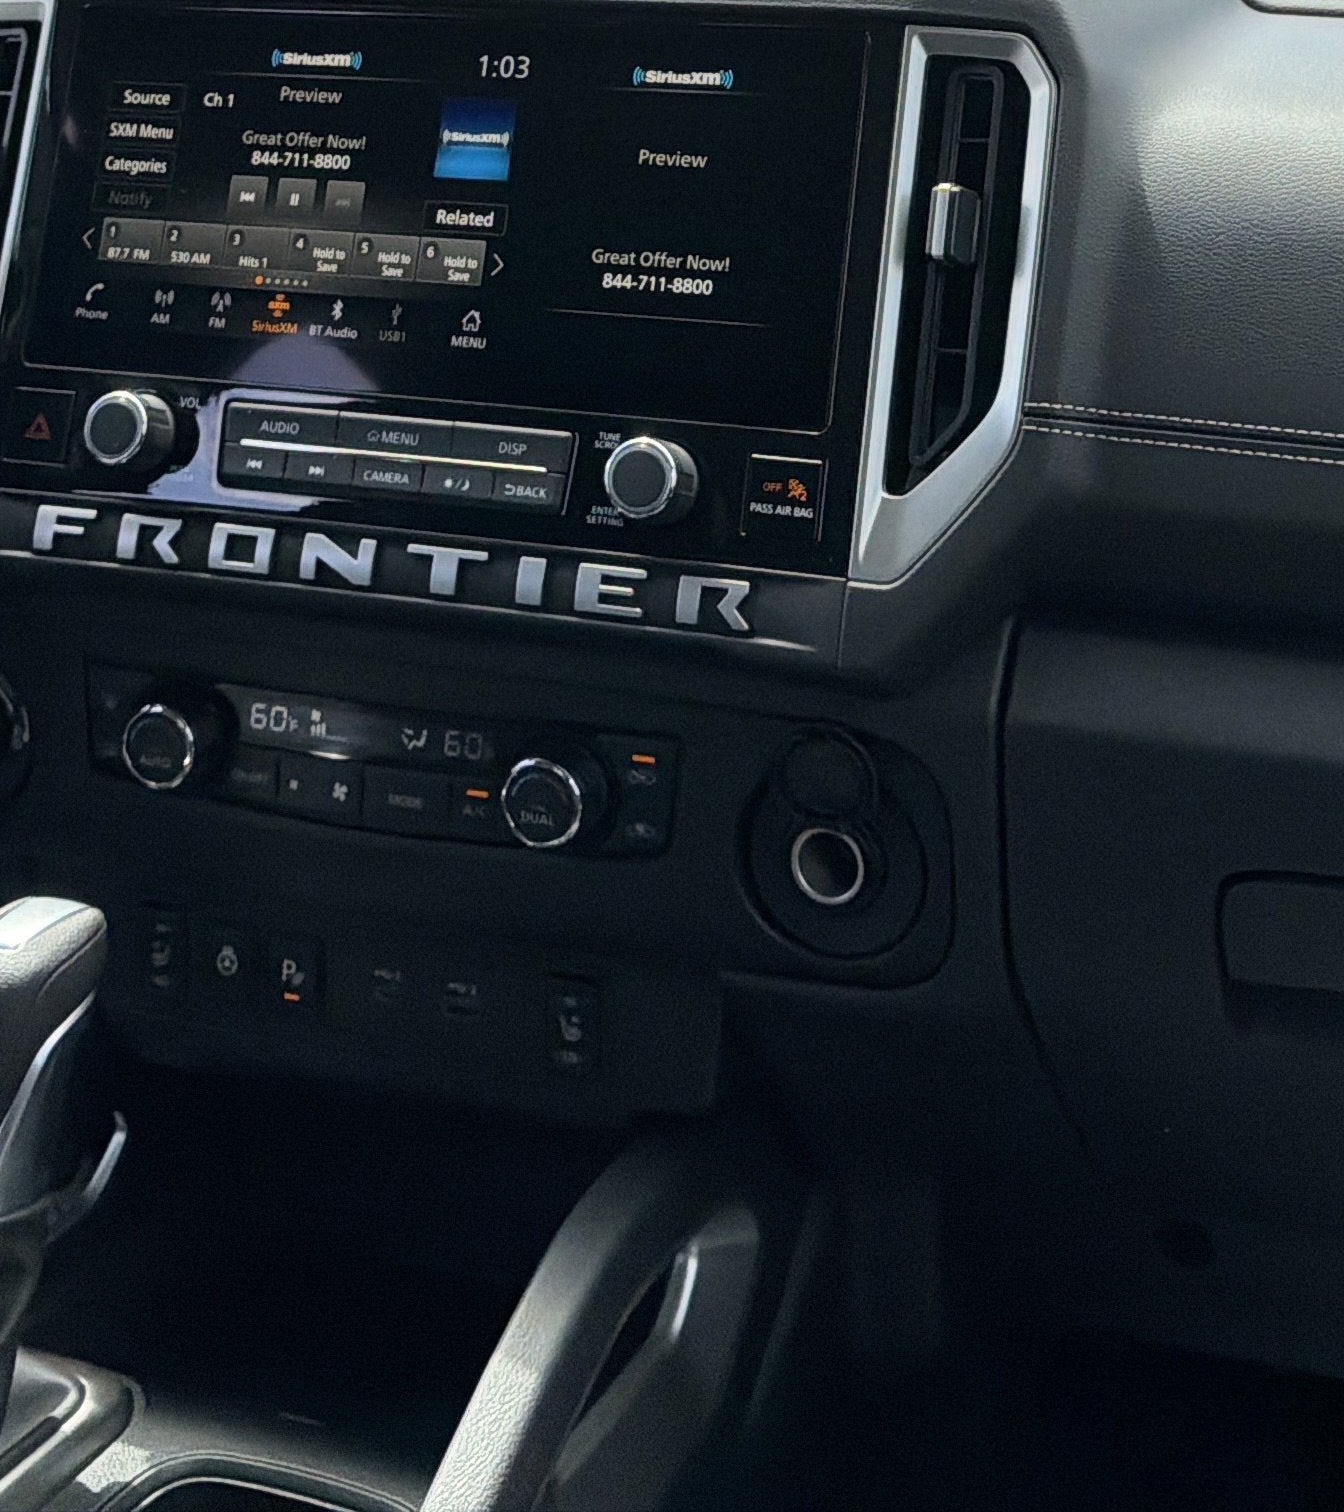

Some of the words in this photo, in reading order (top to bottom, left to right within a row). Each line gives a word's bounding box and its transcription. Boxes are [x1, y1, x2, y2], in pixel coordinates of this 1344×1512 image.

[479, 54, 531, 79] 1:03
[122, 88, 171, 106] Source
[203, 92, 223, 108] Ch
[226, 93, 236, 108] 1
[279, 85, 343, 104] Preview
[109, 121, 138, 138] SXM
[139, 123, 175, 140] Menu
[242, 129, 283, 147] Great
[285, 131, 325, 149] Offer
[327, 134, 367, 151] Now!
[104, 155, 168, 176] Categories
[250, 150, 351, 170] 844-711-8800
[637, 148, 709, 169] Preview
[108, 190, 153, 210] Notify
[435, 208, 495, 228] Related
[109, 225, 117, 238] 1
[169, 229, 179, 242] 2
[231, 233, 241, 246] 3
[295, 237, 305, 250] 4
[360, 241, 370, 254] 5
[132, 248, 150, 261] FM
[190, 252, 211, 265] AM
[312, 246, 334, 260] Hold
[334, 249, 346, 261] to
[377, 251, 400, 264] Hold
[400, 253, 412, 265] to
[426, 246, 435, 258] 6
[238, 255, 260, 268] Hits
[261, 257, 268, 269] 1
[316, 260, 338, 274] Save
[443, 255, 466, 269] Hold
[467, 257, 478, 270] to
[591, 248, 636, 266] Great
[639, 251, 683, 269] Offer
[686, 254, 731, 273] Now!
[381, 265, 404, 278] Save
[447, 269, 471, 283] Save
[602, 272, 714, 295] 844-711-8800
[74, 306, 109, 321] Phone
[150, 312, 171, 325] AM
[208, 316, 226, 329] FM
[251, 319, 299, 335] SiriusXM
[308, 323, 325, 337] BT
[325, 324, 359, 340] Audio
[378, 329, 407, 343] USB1
[450, 334, 487, 350] MENU
[179, 395, 202, 411] VOL
[259, 420, 300, 436] AUDIO
[381, 431, 420, 447] MENU
[594, 440, 620, 450] SCRO
[598, 431, 622, 443] TUNE
[497, 440, 528, 457] DISP
[362, 469, 410, 485] CAMERA
[515, 484, 548, 500] BACK
[762, 481, 783, 493] OFF
[749, 502, 774, 515] PASS
[774, 504, 793, 517] AIR
[793, 506, 814, 519] BAG
[585, 515, 625, 528] SETTING
[32, 503, 753, 634] FRONTIER
[443, 729, 484, 760] 60
[520, 810, 555, 827] DUAL
